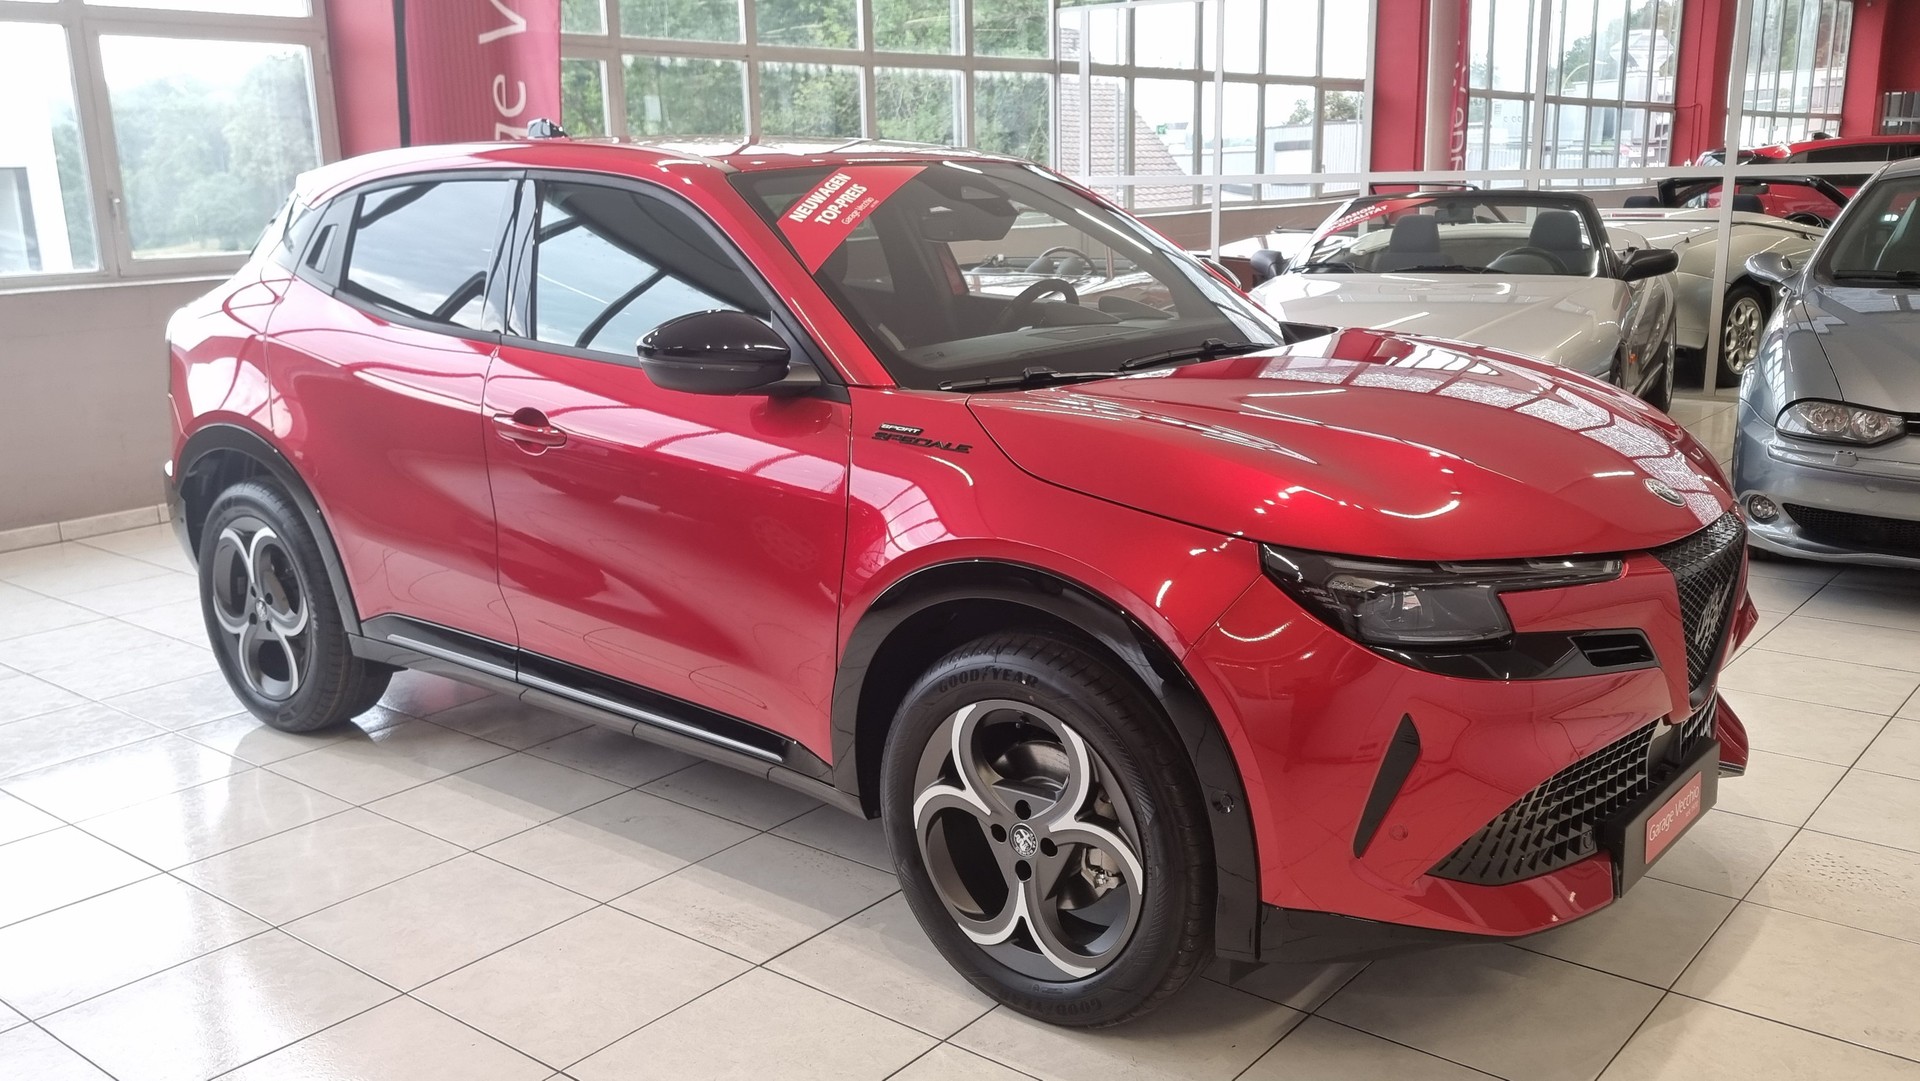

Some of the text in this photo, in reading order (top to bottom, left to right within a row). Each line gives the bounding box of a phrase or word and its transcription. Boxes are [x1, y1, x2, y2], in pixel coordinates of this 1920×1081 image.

[788, 172, 851, 223] NEUWAGEN
[814, 183, 868, 225] TOP-PREIS
[871, 432, 974, 454] SPECIALE
[880, 423, 921, 434] SPORT
[1649, 810, 1674, 841] Garage
[1675, 785, 1700, 817] Vecchio
